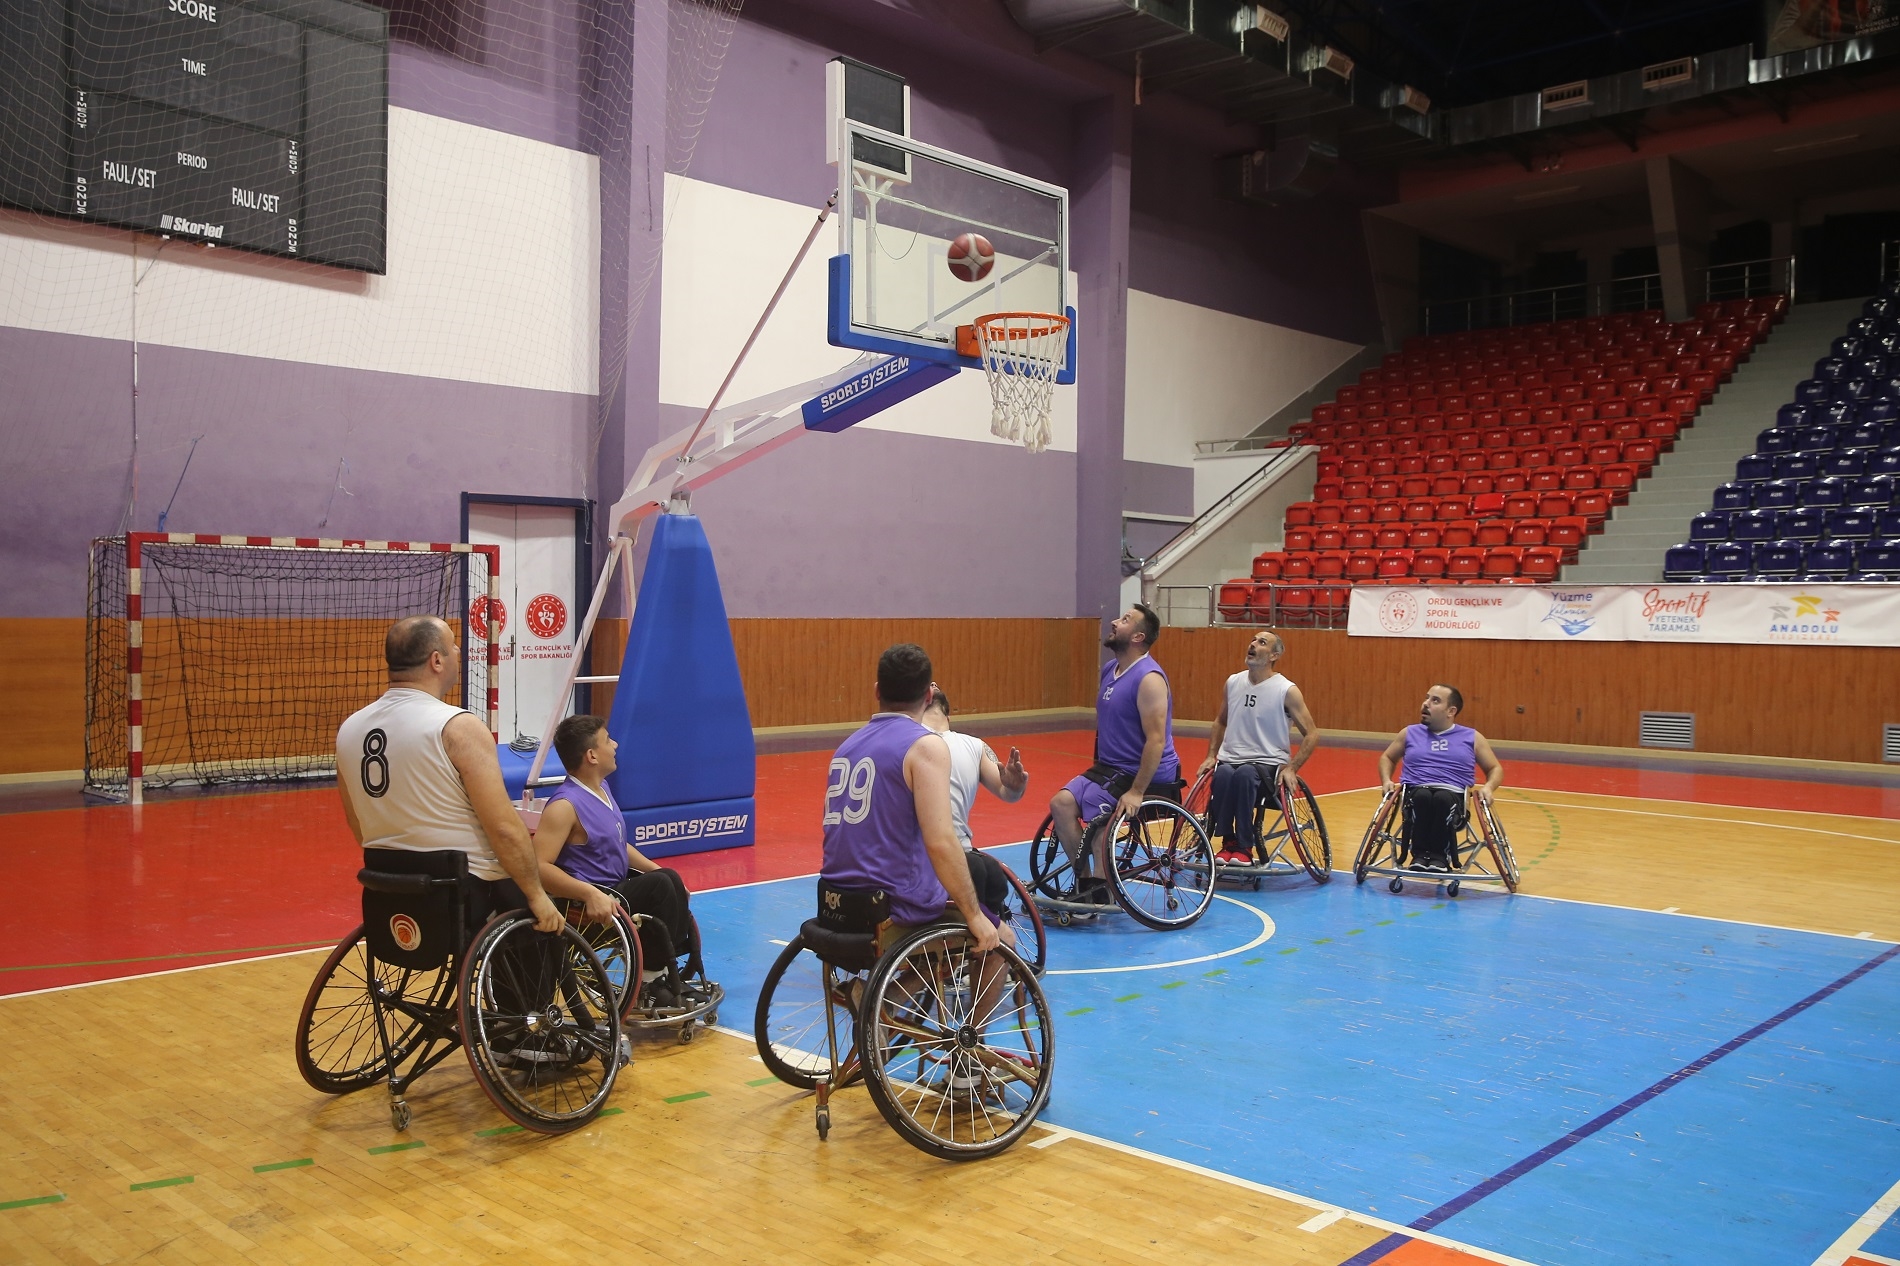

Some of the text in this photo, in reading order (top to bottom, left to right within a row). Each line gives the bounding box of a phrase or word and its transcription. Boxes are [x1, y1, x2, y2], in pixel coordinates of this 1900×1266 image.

[168, 0, 217, 23] SCORE
[181, 58, 207, 77] TIME
[177, 152, 208, 170] PERIOD
[103, 160, 157, 189] FAUL/SET
[76, 176, 87, 215] BONUS
[231, 187, 280, 214] FAUL/SET
[172, 216, 224, 239] Skorled
[288, 218, 297, 253] BONUS
[1427, 597, 1503, 607] ORDU GENÇLİK VE
[1551, 591, 1593, 602] Yüzme
[1426, 608, 1458, 618] SPOR İL
[1642, 588, 1711, 622] Sportif
[1425, 620, 1481, 629] MÜDÜRLÜĞÜ
[1654, 615, 1696, 624] YETENEK
[1648, 623, 1700, 633] TARAMASI
[1770, 624, 1839, 633] ANADOLU
[534, 644, 562, 652] GENÇLİK
[538, 652, 573, 660] BAKANLIĞI
[1244, 694, 1257, 708] 15
[1431, 739, 1449, 752] 22
[361, 728, 390, 798] 8
[823, 756, 876, 826] 29
